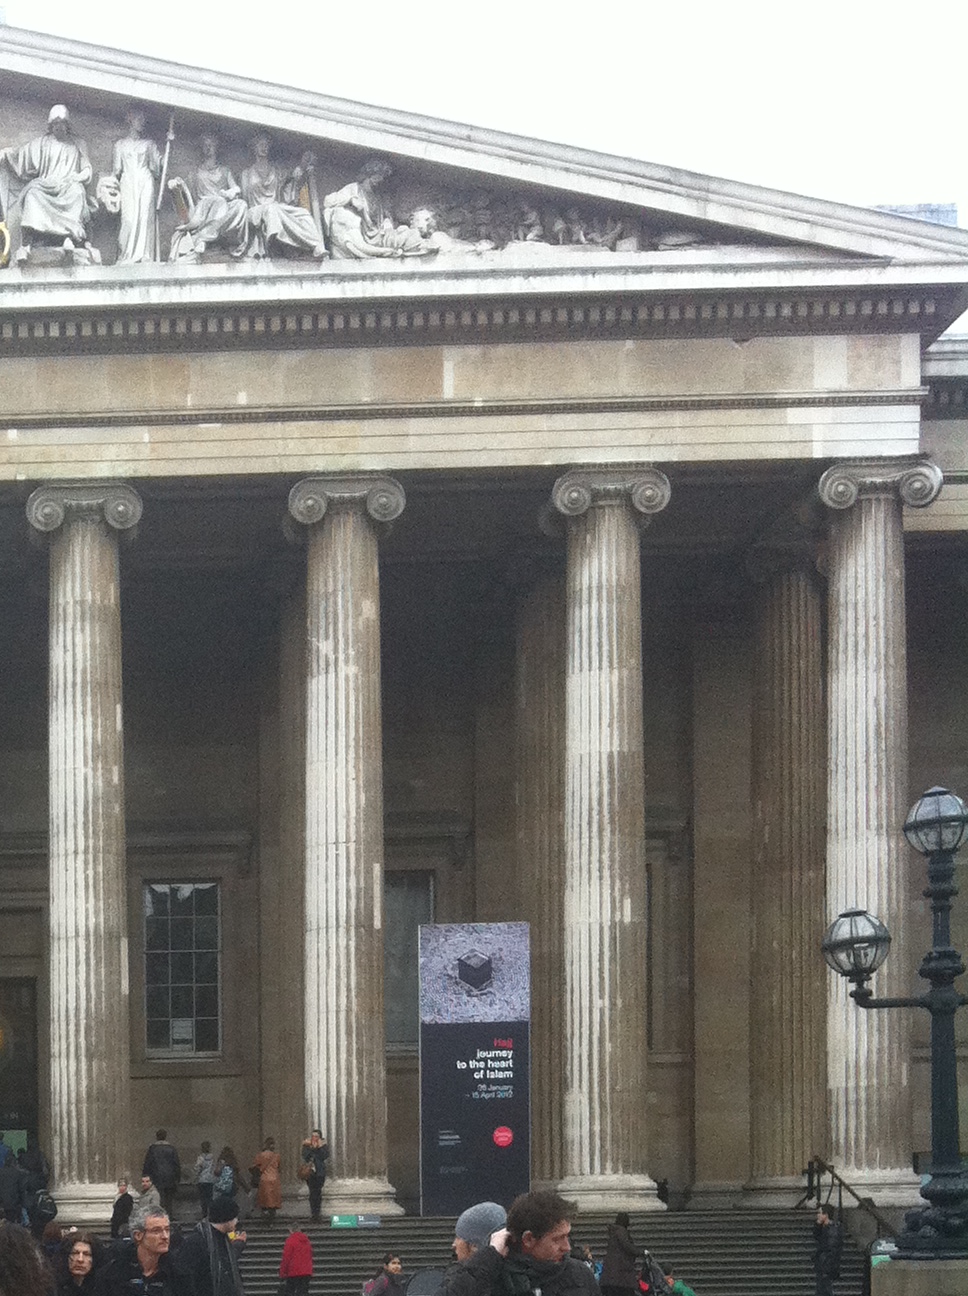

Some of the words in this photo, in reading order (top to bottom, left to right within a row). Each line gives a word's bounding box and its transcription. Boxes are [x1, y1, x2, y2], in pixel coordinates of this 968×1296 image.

[476, 1049, 513, 1059] journey
[456, 1060, 467, 1069] to
[469, 1059, 485, 1069] the
[487, 1059, 513, 1068] heart
[473, 1069, 484, 1079] of
[486, 1069, 513, 1079] Islam
